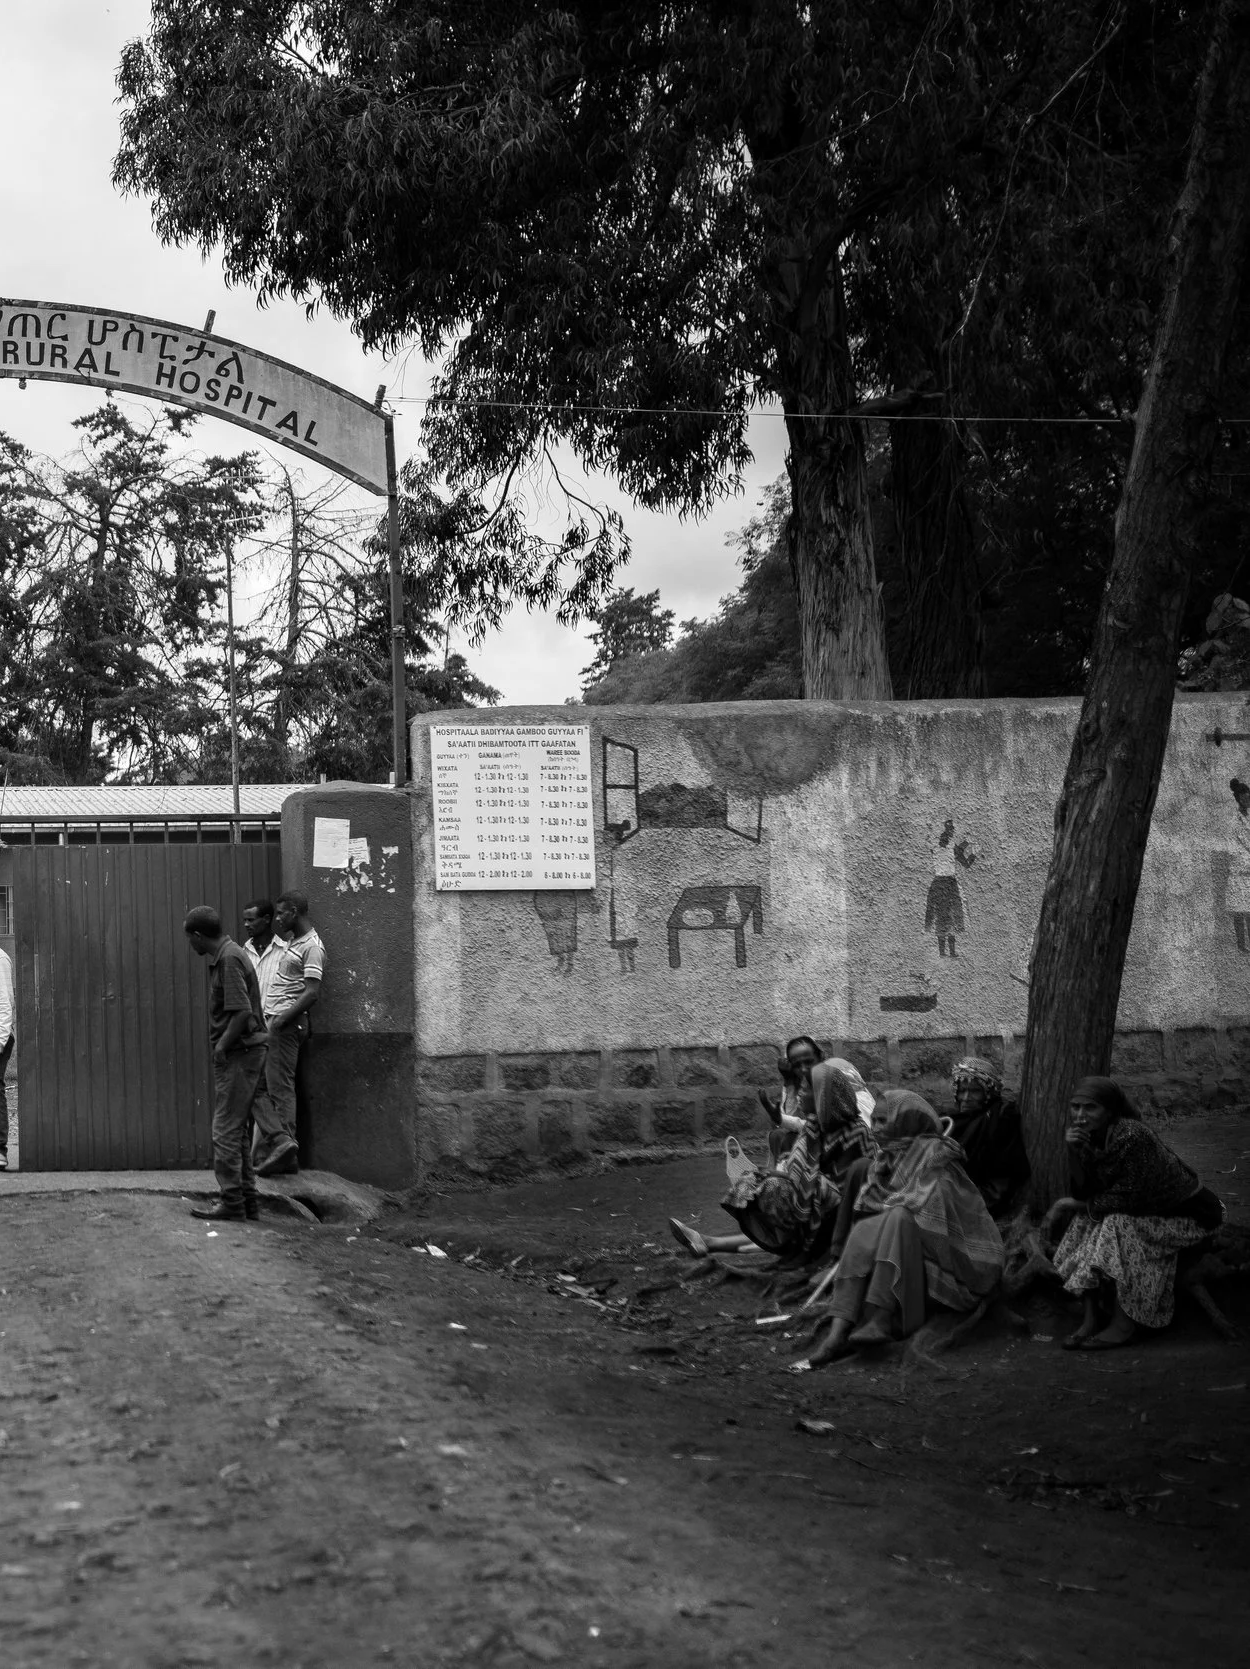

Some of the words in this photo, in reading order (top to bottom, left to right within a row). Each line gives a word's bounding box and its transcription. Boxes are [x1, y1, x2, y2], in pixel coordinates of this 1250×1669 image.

[88, 319, 245, 384] ሆስፒታል
[2, 340, 120, 376] RURAL
[156, 362, 318, 446] HOSPITAL
[436, 728, 479, 736] HOSPITAALA
[480, 728, 515, 736] BADIYYAA
[516, 728, 546, 736] GAMBOO
[547, 728, 576, 736] GUYYAA
[447, 740, 477, 748] SA'AATII
[477, 740, 527, 748] DHIBAMTOOTA
[541, 740, 576, 748] GAAFATAN
[474, 772, 481, 780] 12
[475, 799, 483, 807] 12
[476, 816, 483, 824] 12
[508, 816, 515, 824] 12
[540, 817, 544, 826] 7
[569, 818, 572, 826] 7
[477, 834, 484, 842] 12
[478, 852, 485, 860] 12
[510, 852, 517, 860] 12
